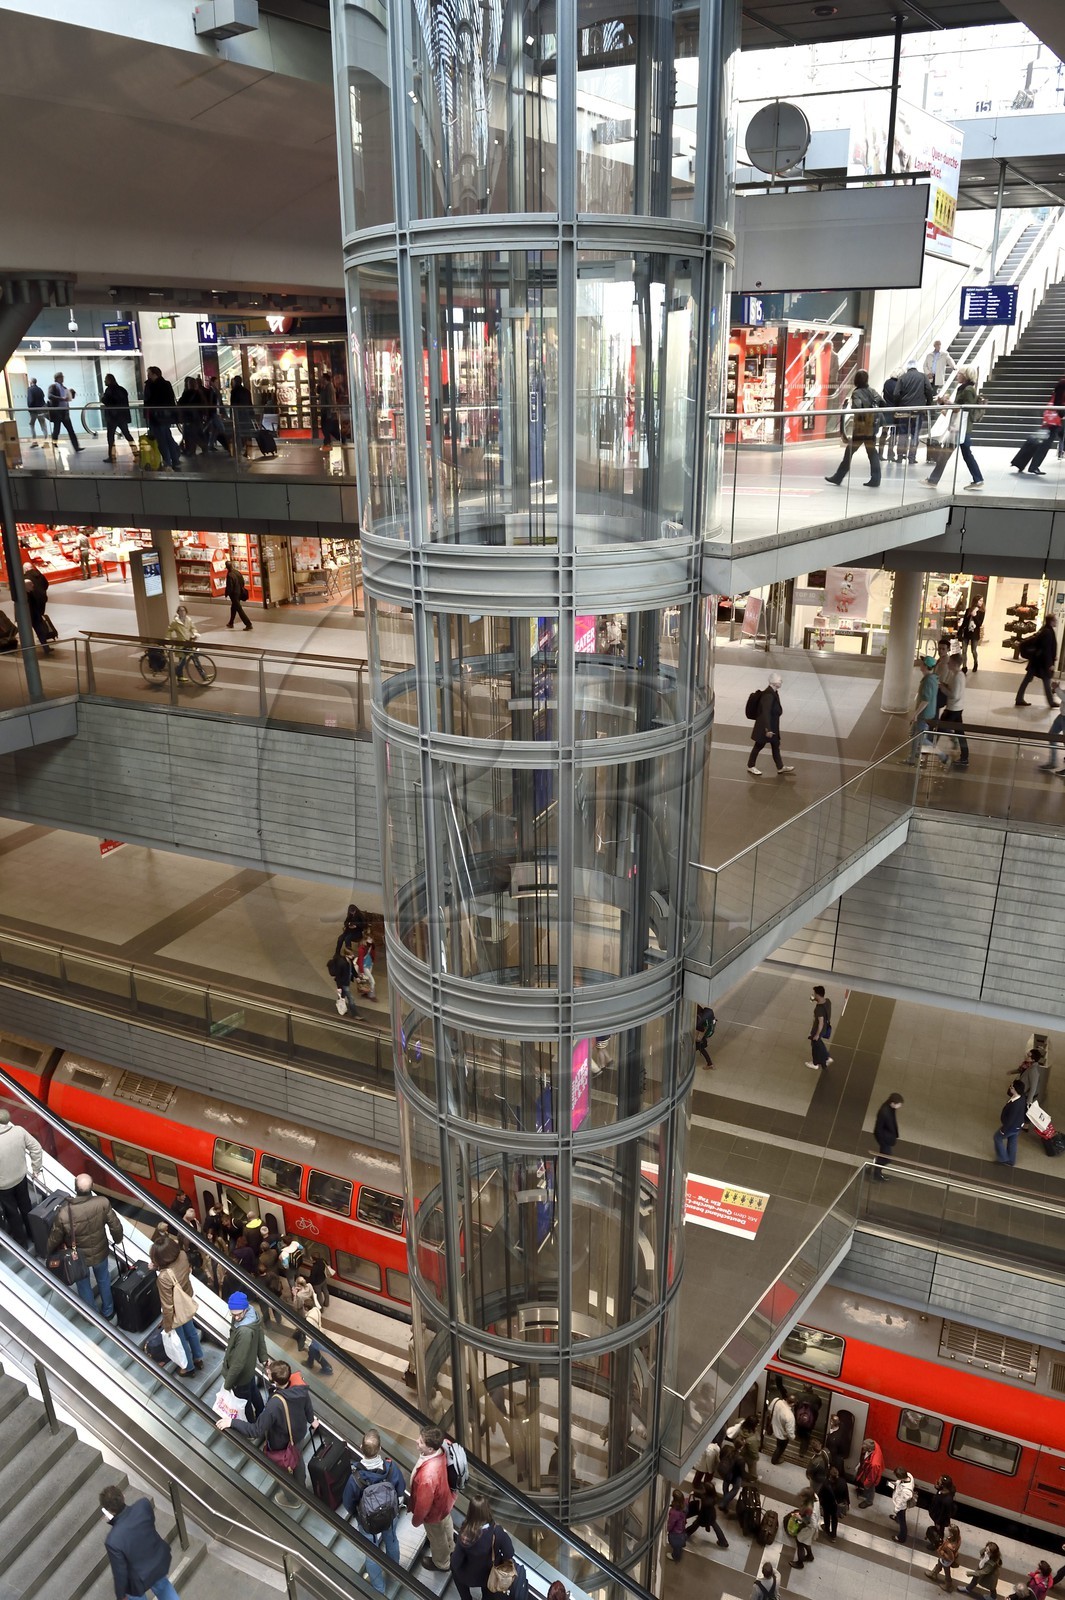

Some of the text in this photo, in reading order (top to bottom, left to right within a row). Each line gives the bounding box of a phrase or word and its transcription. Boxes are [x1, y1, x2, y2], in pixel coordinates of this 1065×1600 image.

[200, 322, 215, 339] 14
[697, 1195, 709, 1204] Tag
[705, 1209, 747, 1225] Deutschland
[733, 1211, 747, 1220] dem
